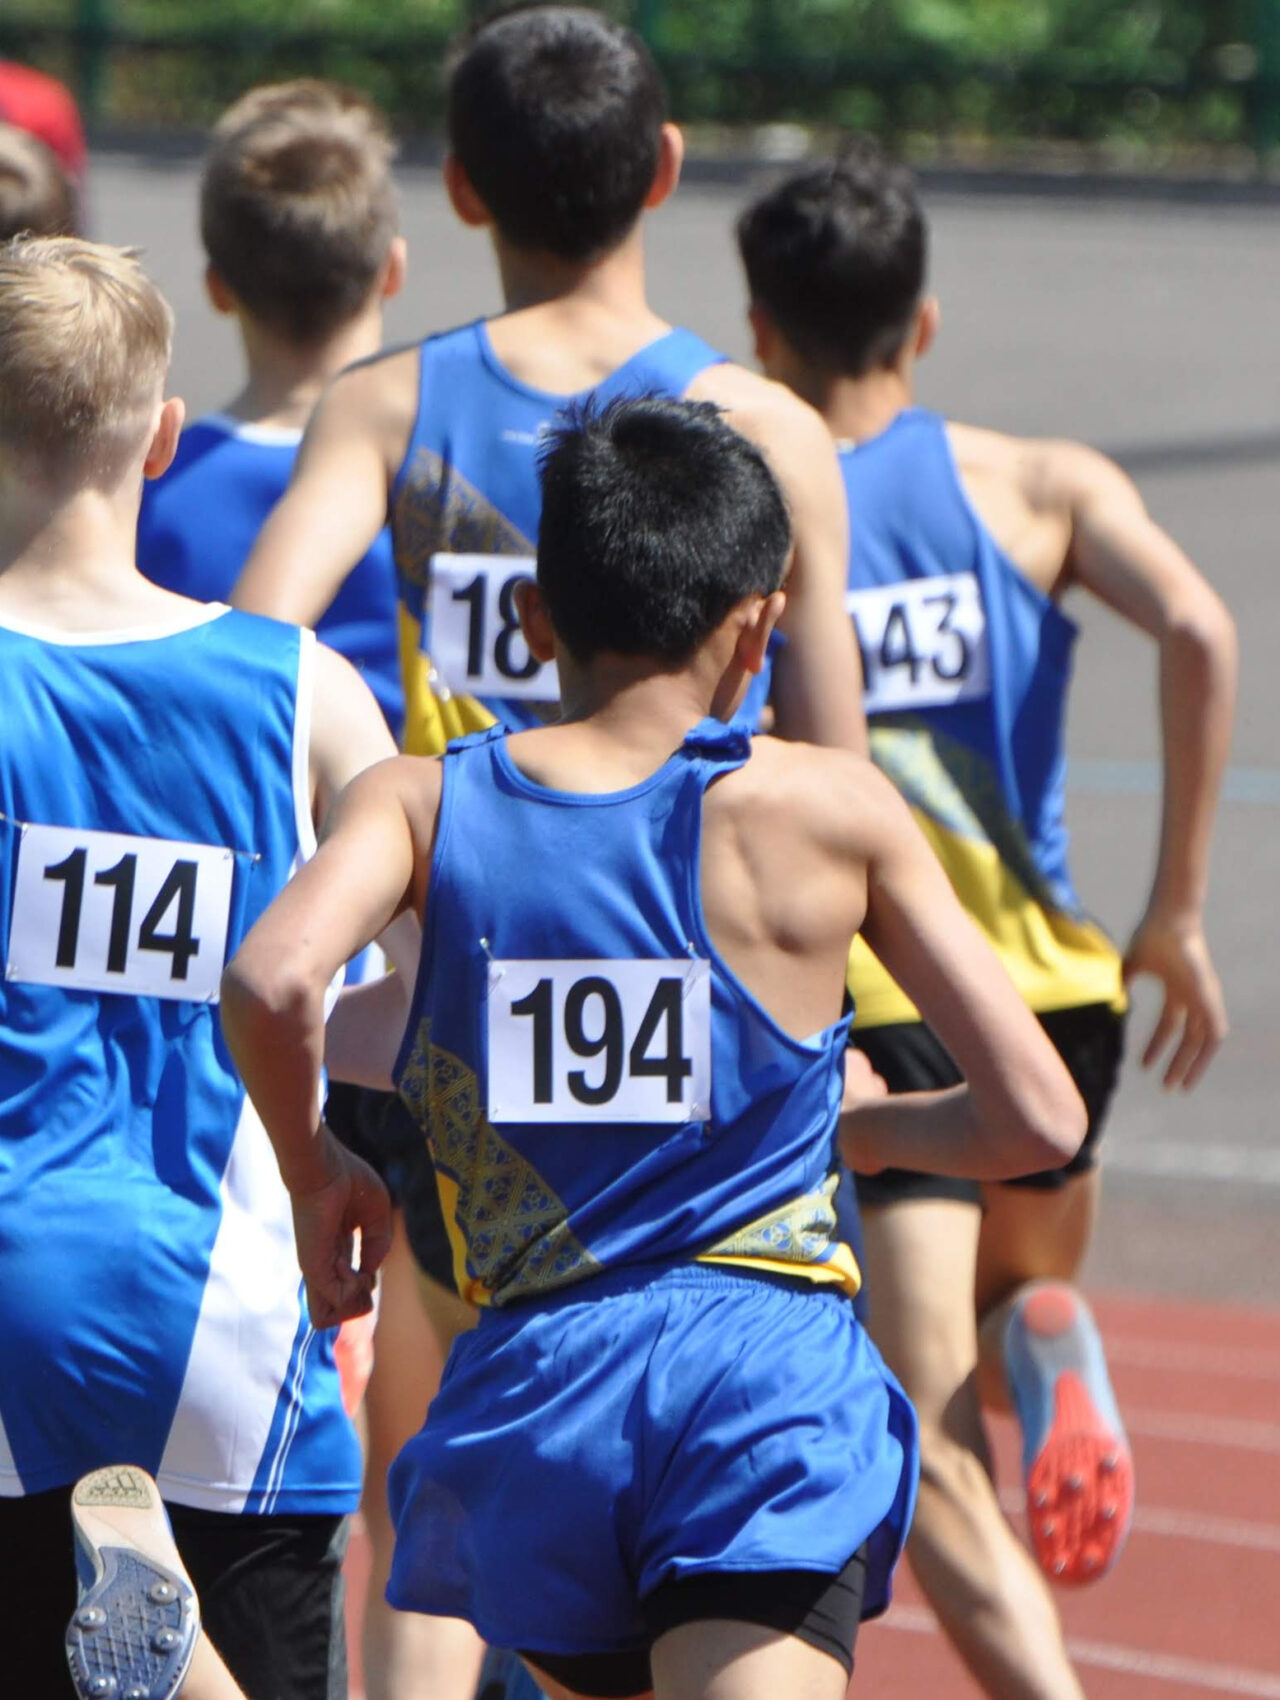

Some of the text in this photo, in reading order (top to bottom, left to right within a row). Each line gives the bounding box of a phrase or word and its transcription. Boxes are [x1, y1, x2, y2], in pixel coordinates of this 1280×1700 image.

[452, 571, 548, 679] 18
[43, 845, 200, 981] 114
[510, 974, 692, 1107] 194
